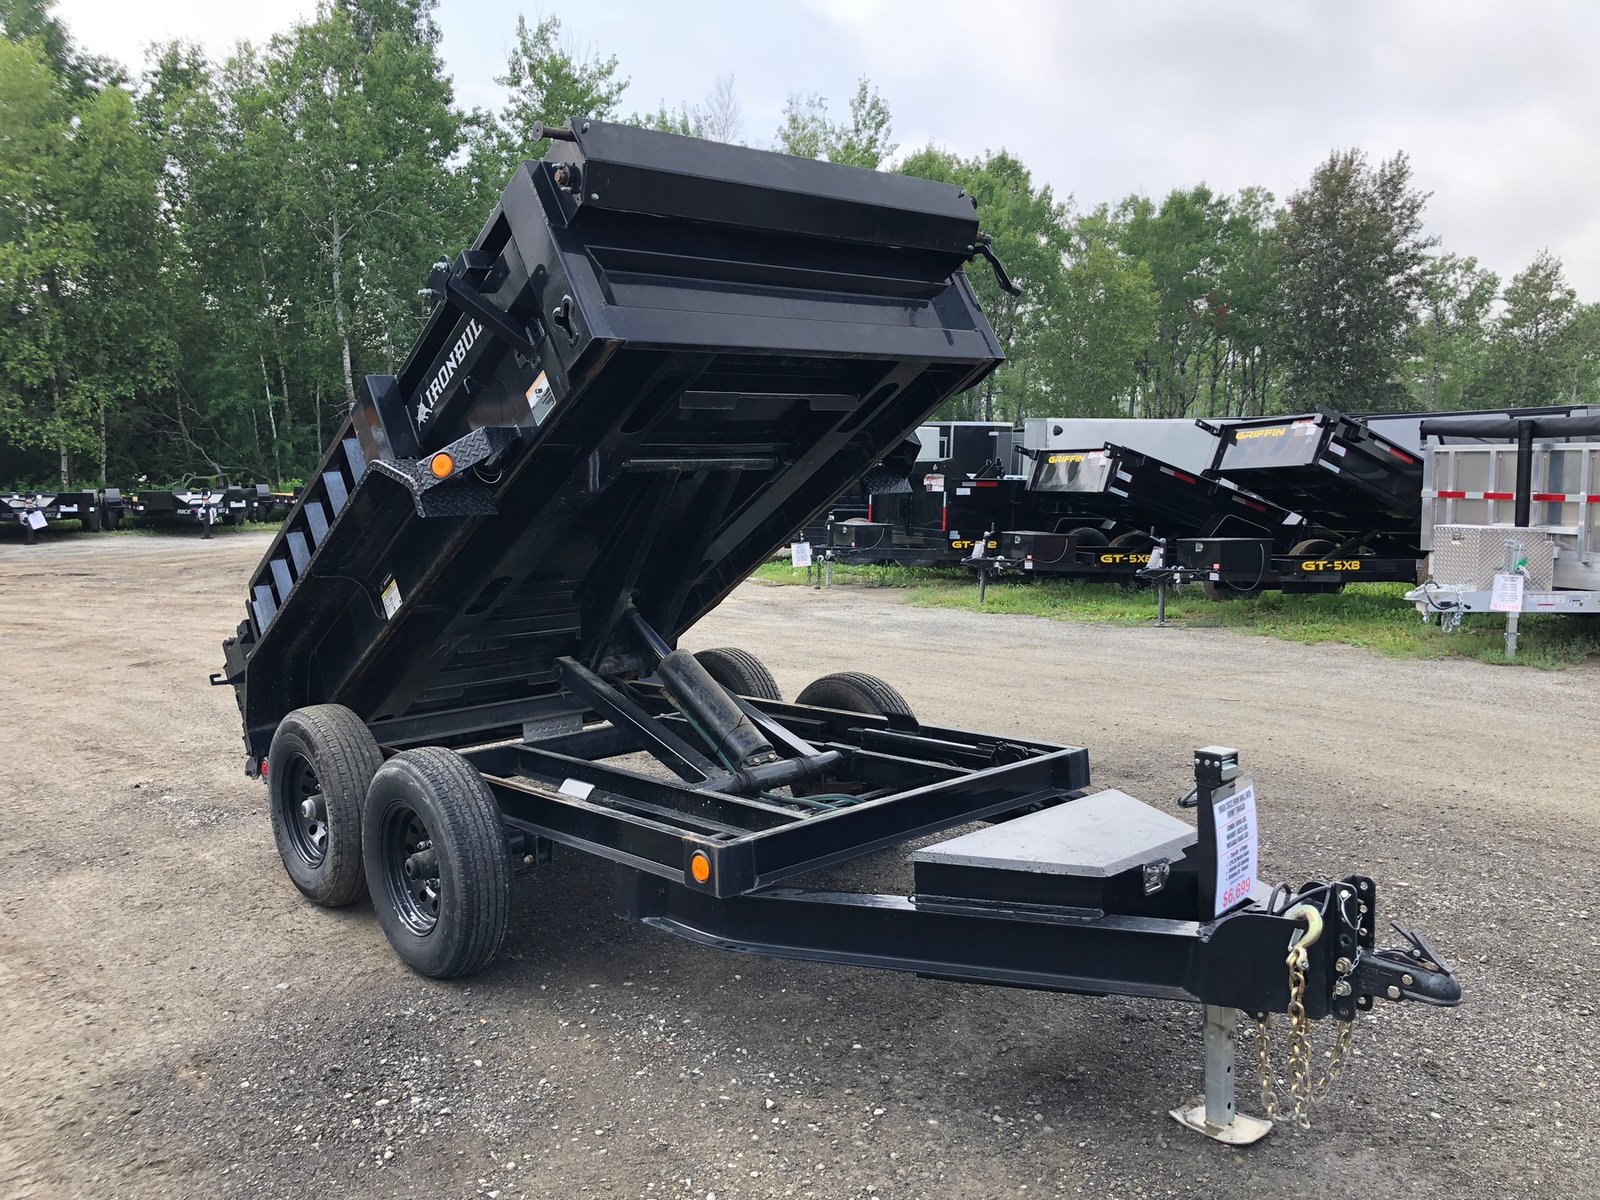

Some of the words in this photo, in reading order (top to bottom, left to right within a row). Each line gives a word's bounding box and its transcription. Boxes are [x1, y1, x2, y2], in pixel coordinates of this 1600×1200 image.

[425, 318, 484, 409] IRONBUL
[1236, 428, 1286, 440] GRIFFIN
[1048, 455, 1085, 464] GRIFFIN
[1301, 560, 1361, 571] GT-5X8
[1223, 877, 1251, 908] $6,699
